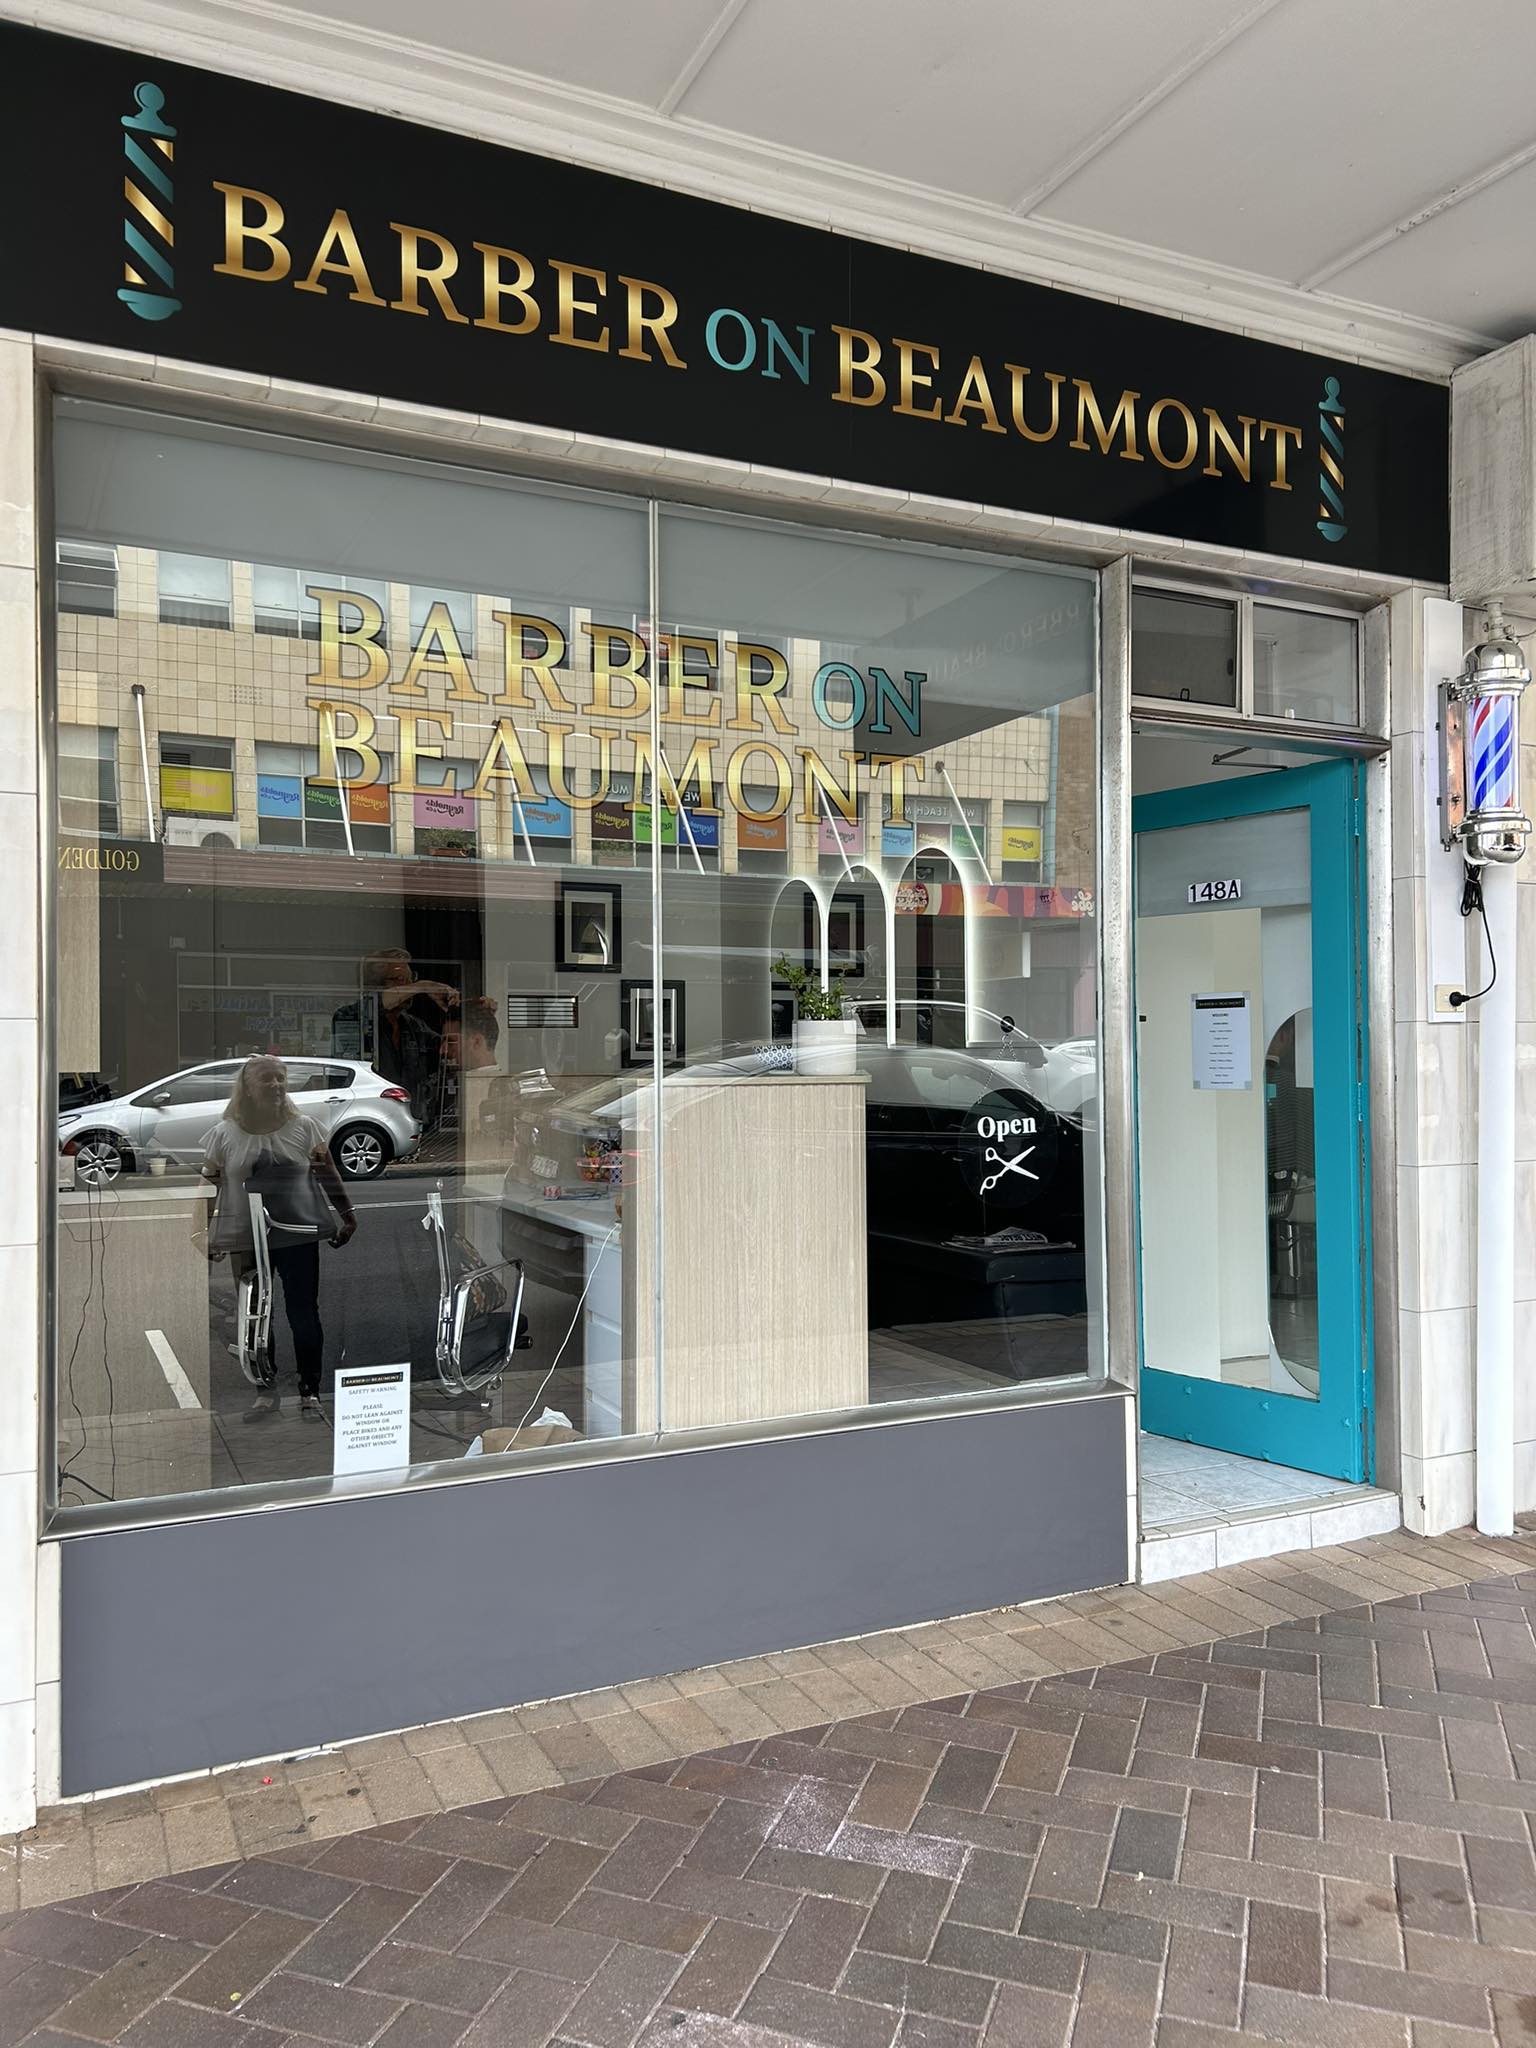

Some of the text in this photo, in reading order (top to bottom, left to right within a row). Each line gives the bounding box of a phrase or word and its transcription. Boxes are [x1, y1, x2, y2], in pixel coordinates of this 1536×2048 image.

[212, 181, 1303, 492] BARBER ON BEAUMONT
[305, 585, 928, 737] BARBER ON
[305, 697, 926, 828] BEAUMONT
[1190, 879, 1240, 901] 148A
[977, 1116, 1037, 1142] Open
[371, 1432, 394, 1440] OBJECTS
[372, 1439, 397, 1447] WINDOW
